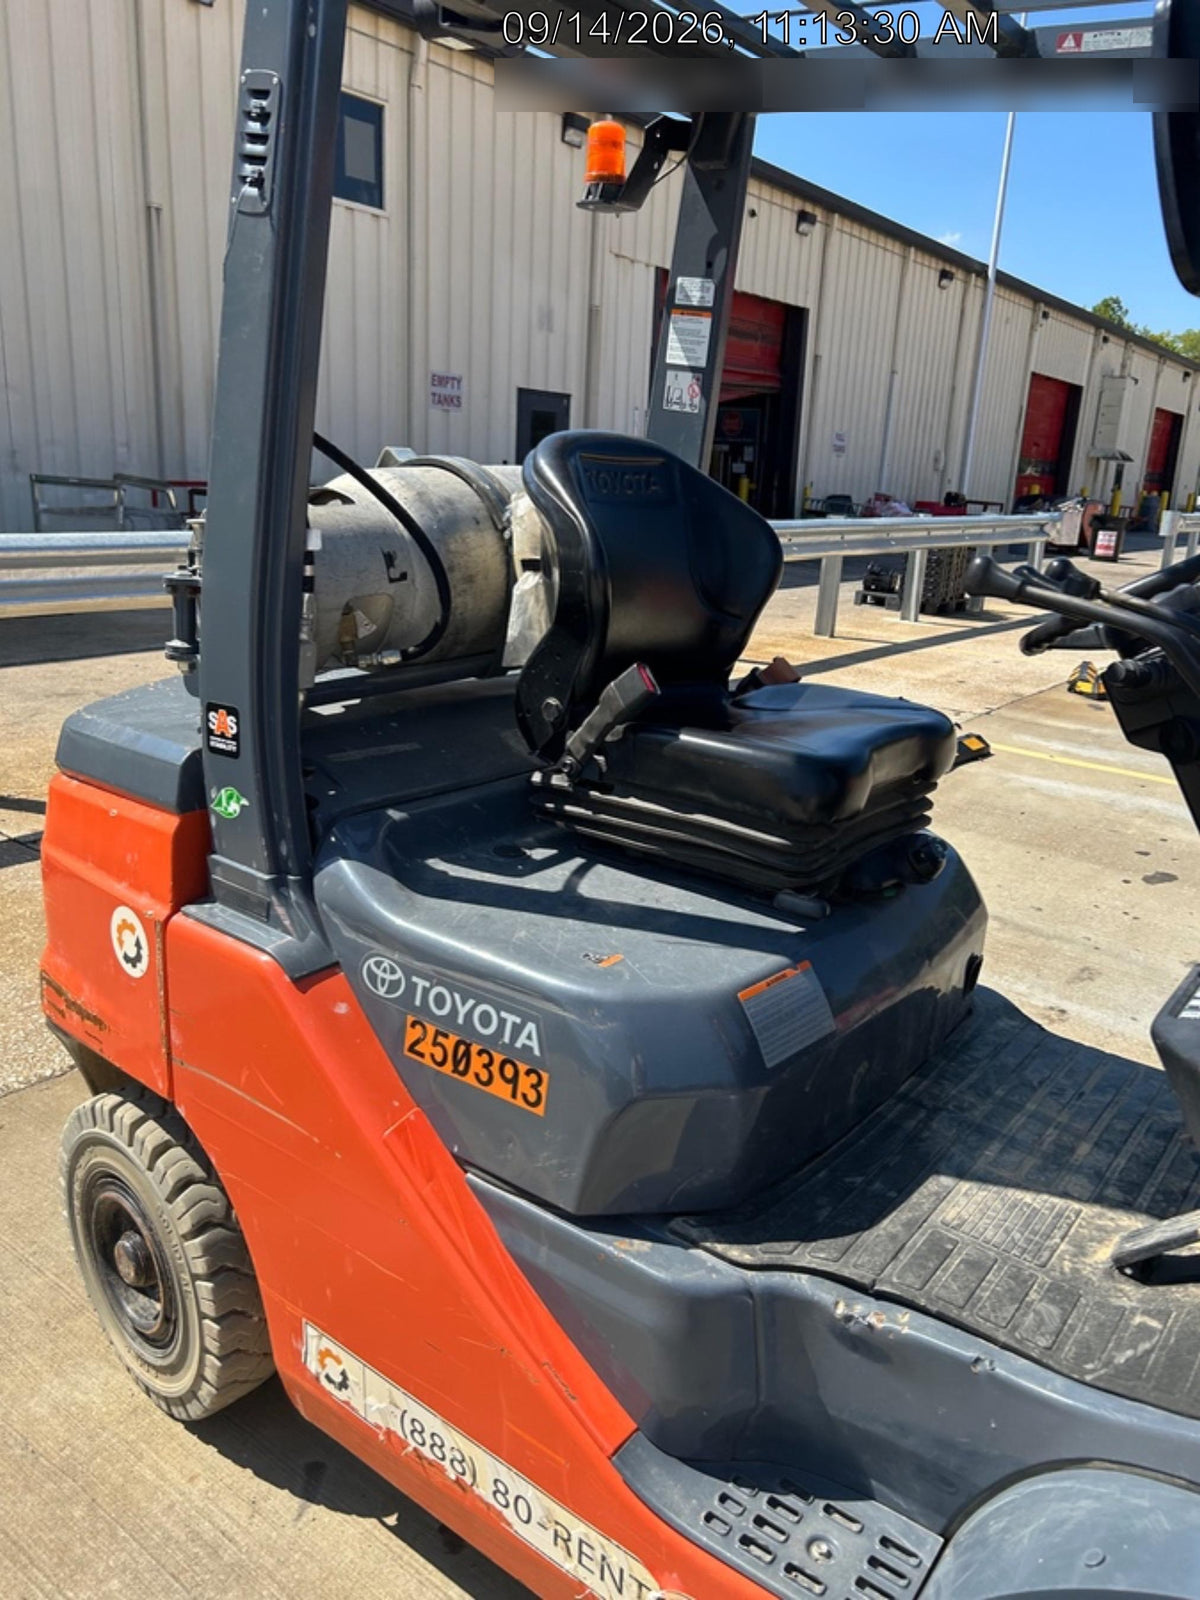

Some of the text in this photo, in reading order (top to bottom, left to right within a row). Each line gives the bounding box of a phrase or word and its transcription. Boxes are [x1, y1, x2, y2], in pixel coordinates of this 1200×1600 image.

[431, 374, 463, 391] EMPTY
[431, 392, 462, 408] TANKS
[208, 709, 238, 738] SAS
[411, 975, 541, 1057] TOYOTA
[407, 1020, 544, 1109] 250393
[400, 1409, 478, 1487] (888)
